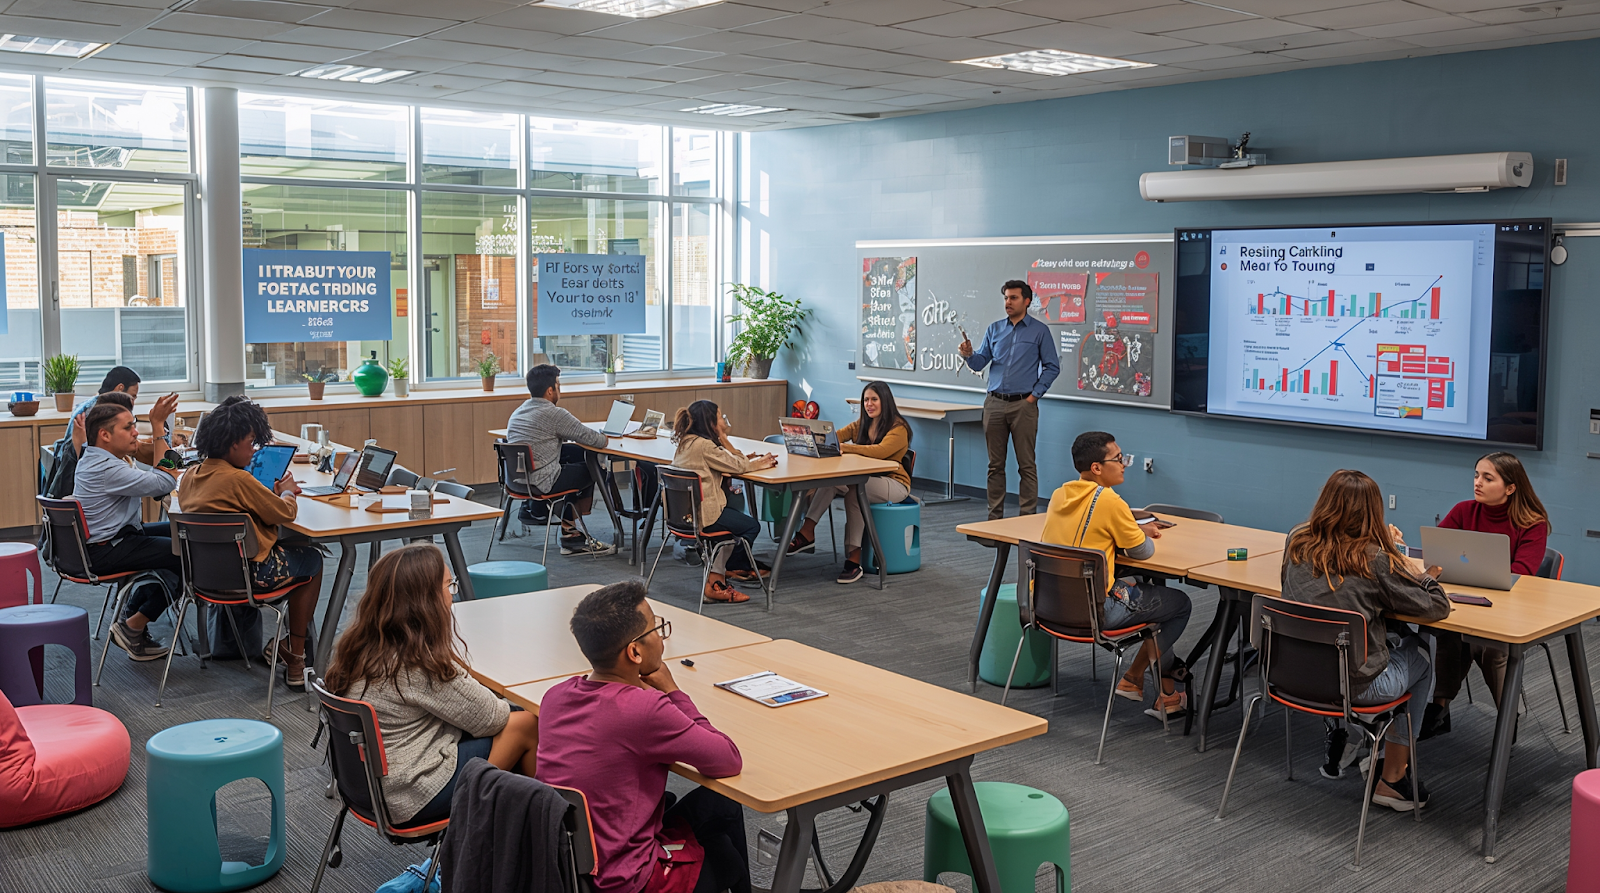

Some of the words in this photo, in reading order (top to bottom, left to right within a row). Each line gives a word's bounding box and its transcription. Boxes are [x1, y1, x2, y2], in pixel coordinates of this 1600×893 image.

[337, 265, 376, 279] YOUR
[258, 282, 320, 296] FOETAC
[546, 290, 580, 304] Your
[582, 293, 595, 304] to
